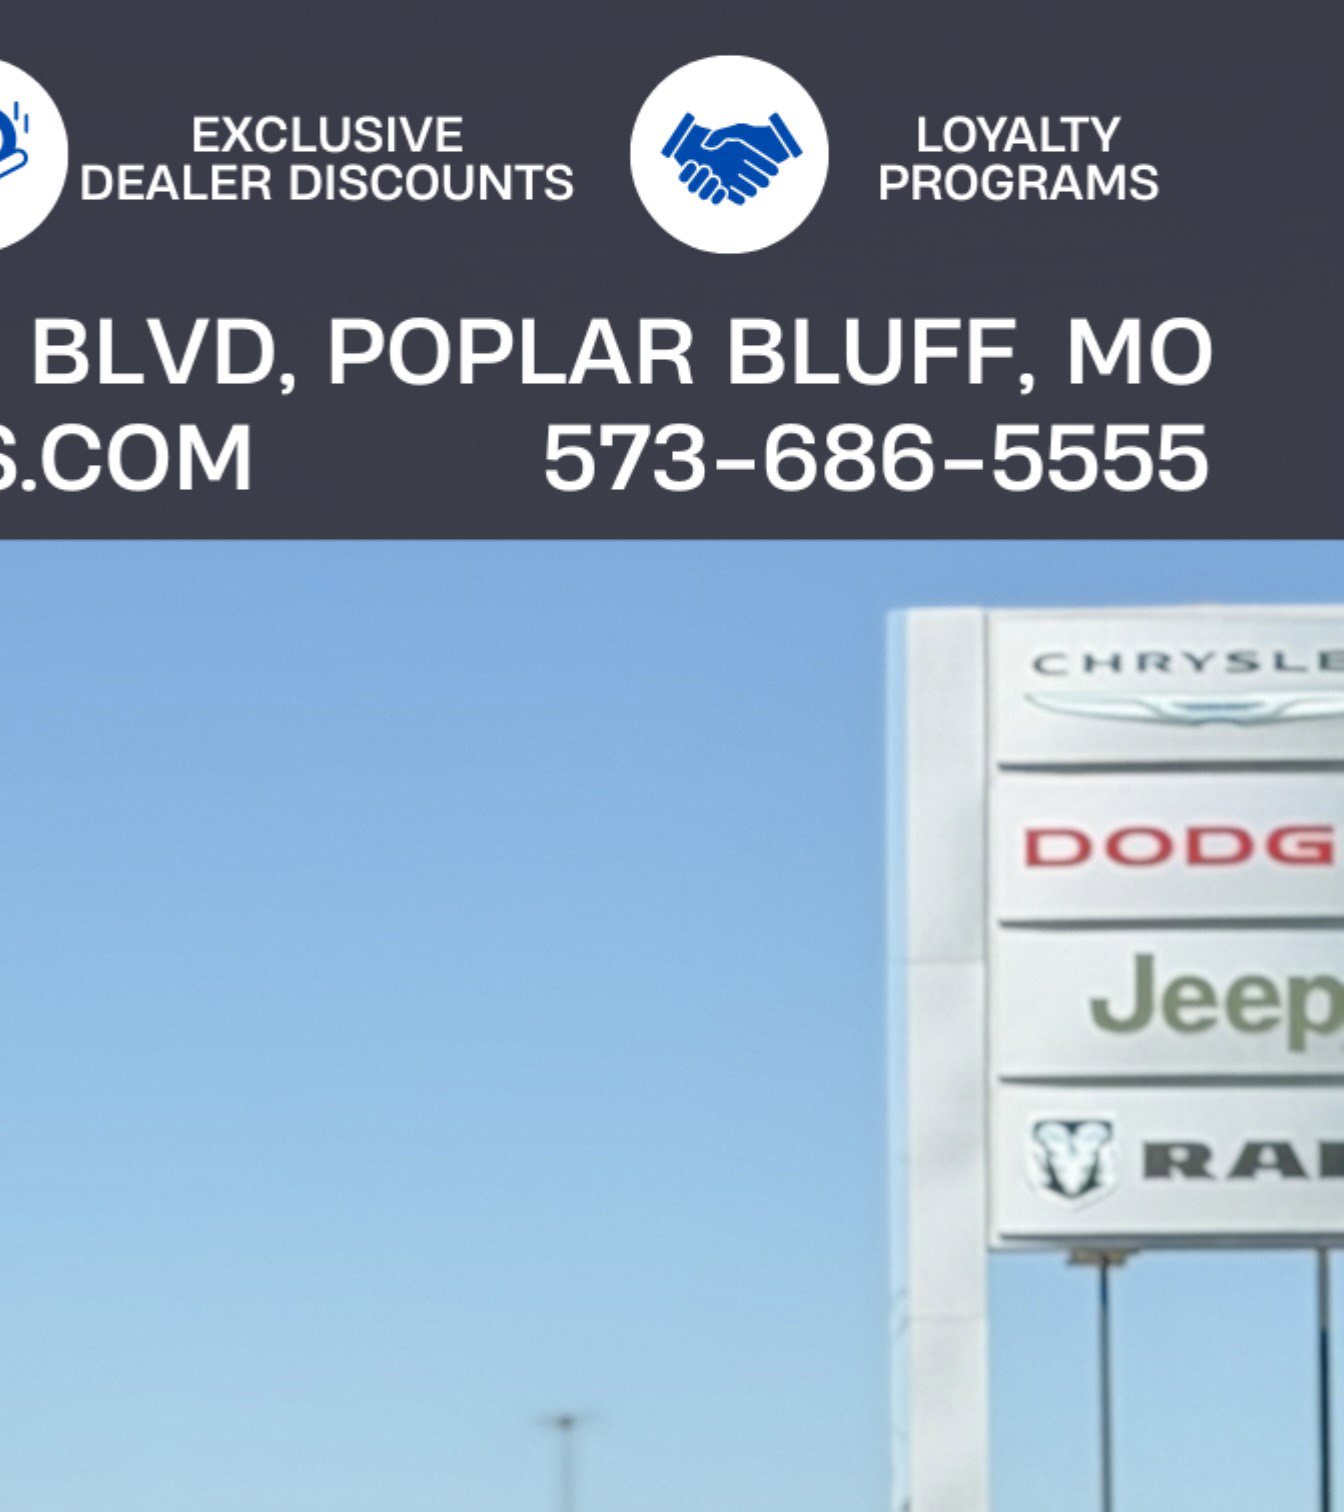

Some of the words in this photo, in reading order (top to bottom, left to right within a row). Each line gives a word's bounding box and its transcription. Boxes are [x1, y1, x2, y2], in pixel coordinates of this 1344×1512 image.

[1024, 826, 1334, 866] DODG
[1089, 953, 1344, 1053] Jeep
[1142, 1140, 1344, 1180] RA
